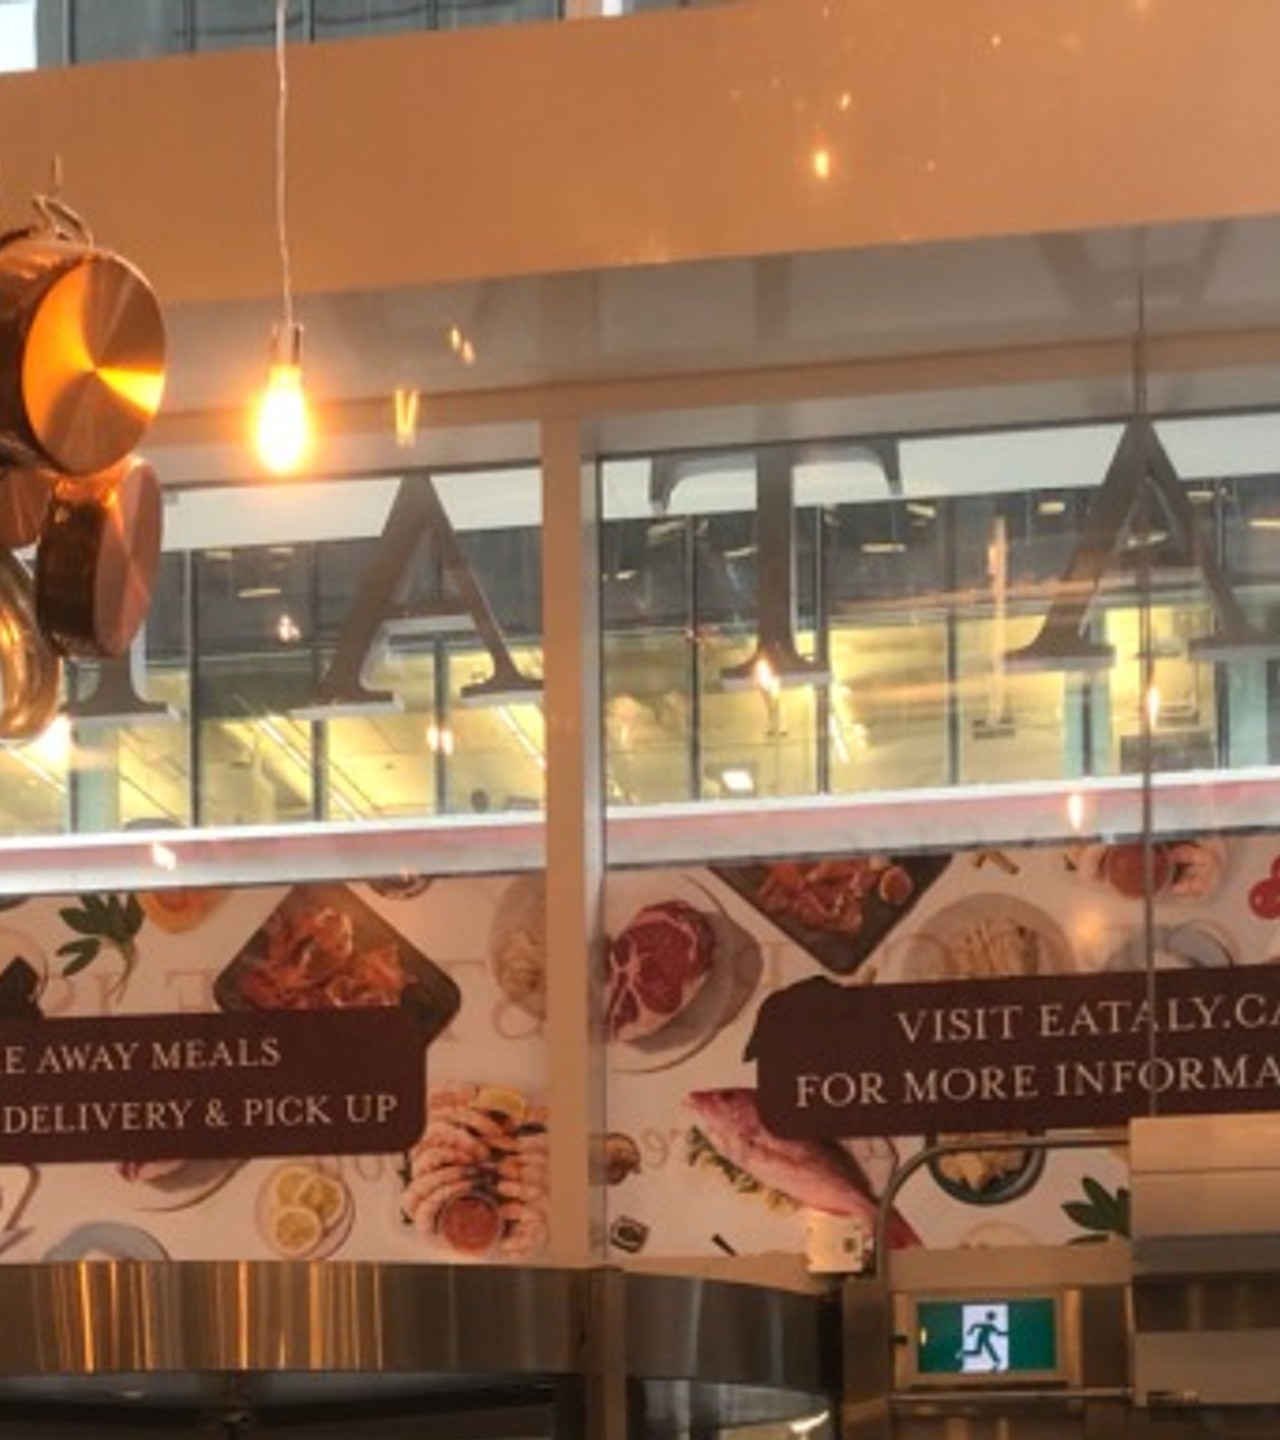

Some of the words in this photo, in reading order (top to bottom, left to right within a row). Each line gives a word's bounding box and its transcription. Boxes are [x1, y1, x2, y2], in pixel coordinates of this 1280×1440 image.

[896, 1006, 1022, 1045] VISIT
[38, 1043, 142, 1075] AWAY
[151, 1037, 281, 1072] MEALS
[796, 1071, 889, 1108] FOR
[904, 1065, 1040, 1103] MORE
[2, 1100, 194, 1136] DELIVERY
[204, 1100, 230, 1128] &
[243, 1096, 331, 1128] PICK
[345, 1094, 398, 1125] UP
